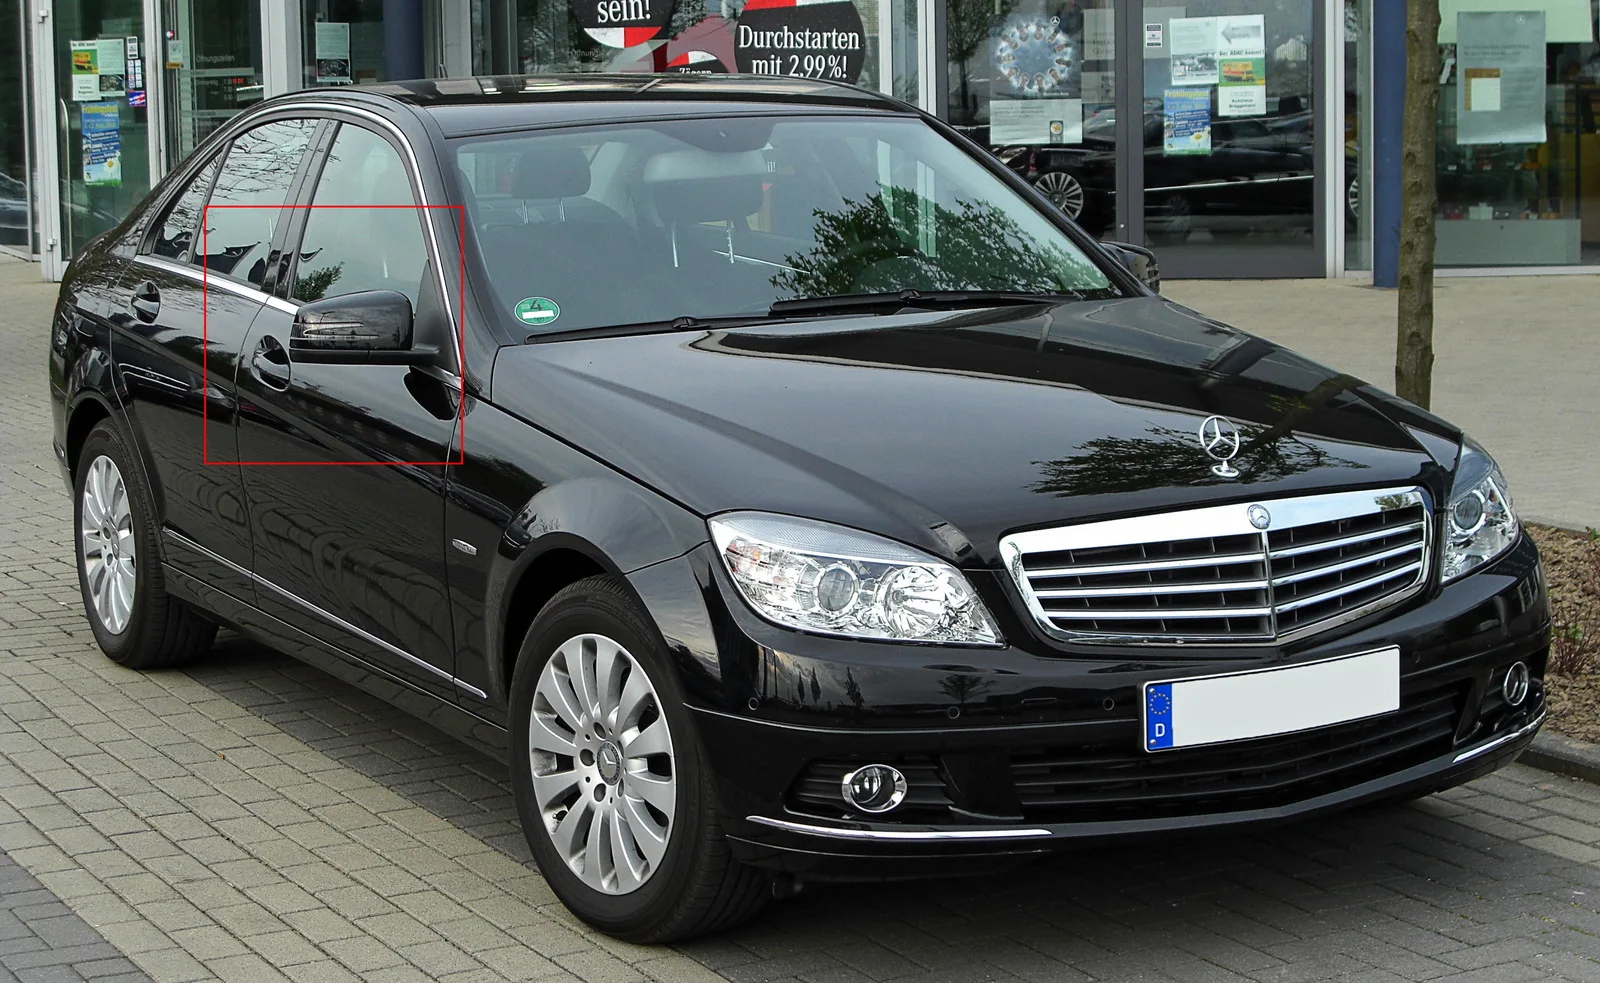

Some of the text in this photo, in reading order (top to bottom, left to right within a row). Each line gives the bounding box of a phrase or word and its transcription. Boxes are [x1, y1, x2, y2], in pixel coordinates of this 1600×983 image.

[598, 0, 651, 23] sein!
[739, 25, 860, 50] Durchstarten
[752, 54, 782, 75] mit
[530, 299, 543, 311] 4
[1155, 723, 1165, 737] D
